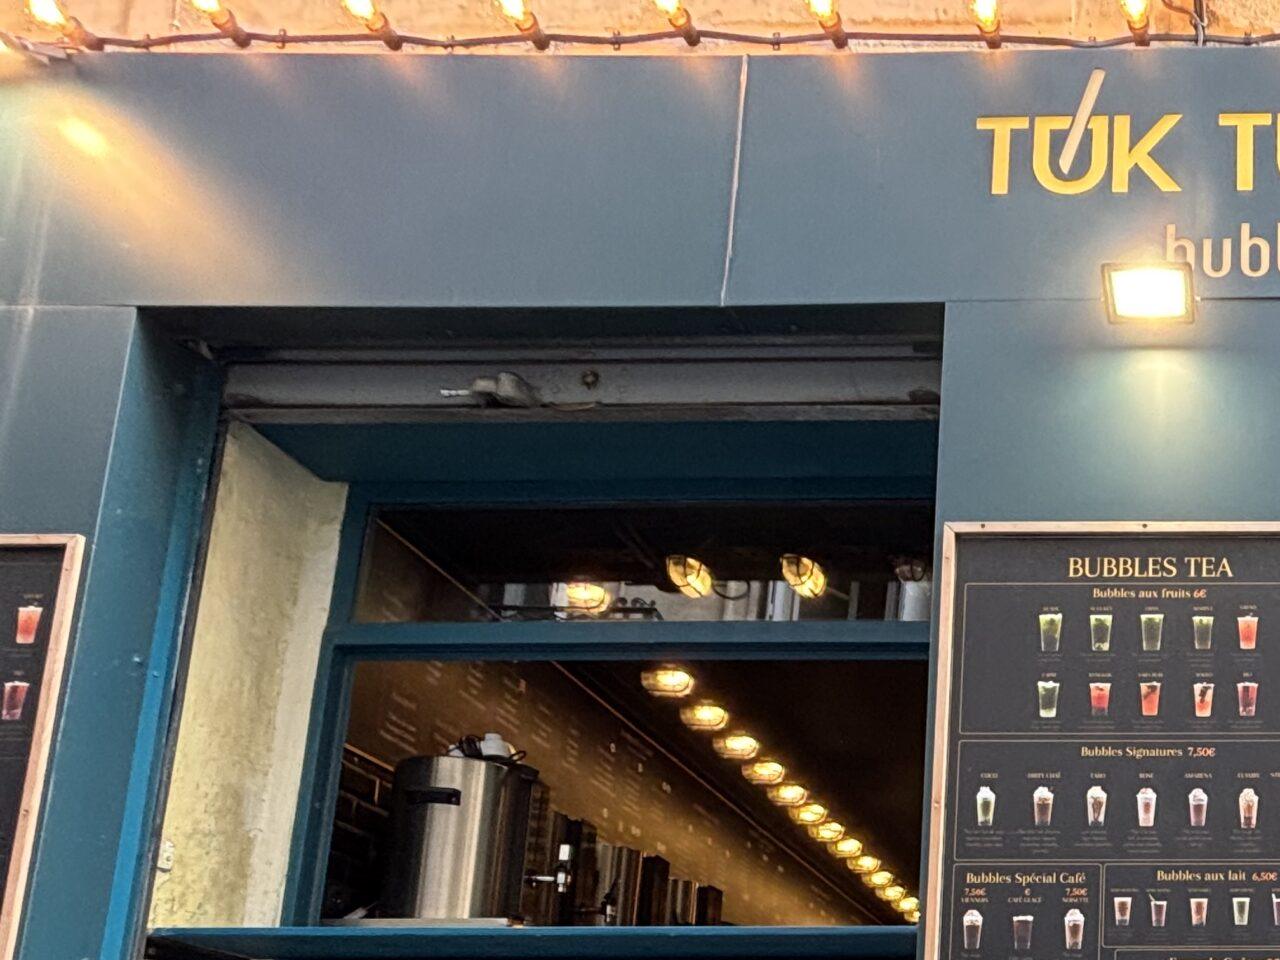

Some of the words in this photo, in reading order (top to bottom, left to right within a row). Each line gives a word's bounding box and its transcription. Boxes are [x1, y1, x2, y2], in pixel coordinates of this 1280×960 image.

[977, 68, 1182, 194] TUK
[1068, 556, 1178, 578] BUBBLES
[1184, 556, 1234, 578] TEA
[1092, 587, 1136, 599] Bubbles
[1138, 590, 1159, 599] aux
[1161, 587, 1192, 599] fruits
[1193, 588, 1207, 599] 6€
[1080, 746, 1123, 757] Bubbles
[1125, 746, 1183, 760] Signatures
[1187, 746, 1216, 758] 7,50€
[966, 872, 1012, 884] Bubbles
[1014, 871, 1057, 887] Spécial
[1059, 872, 1086, 884] Café
[1156, 869, 1202, 881] Bubbles
[1203, 872, 1225, 881] aux
[1227, 869, 1246, 881] lait
